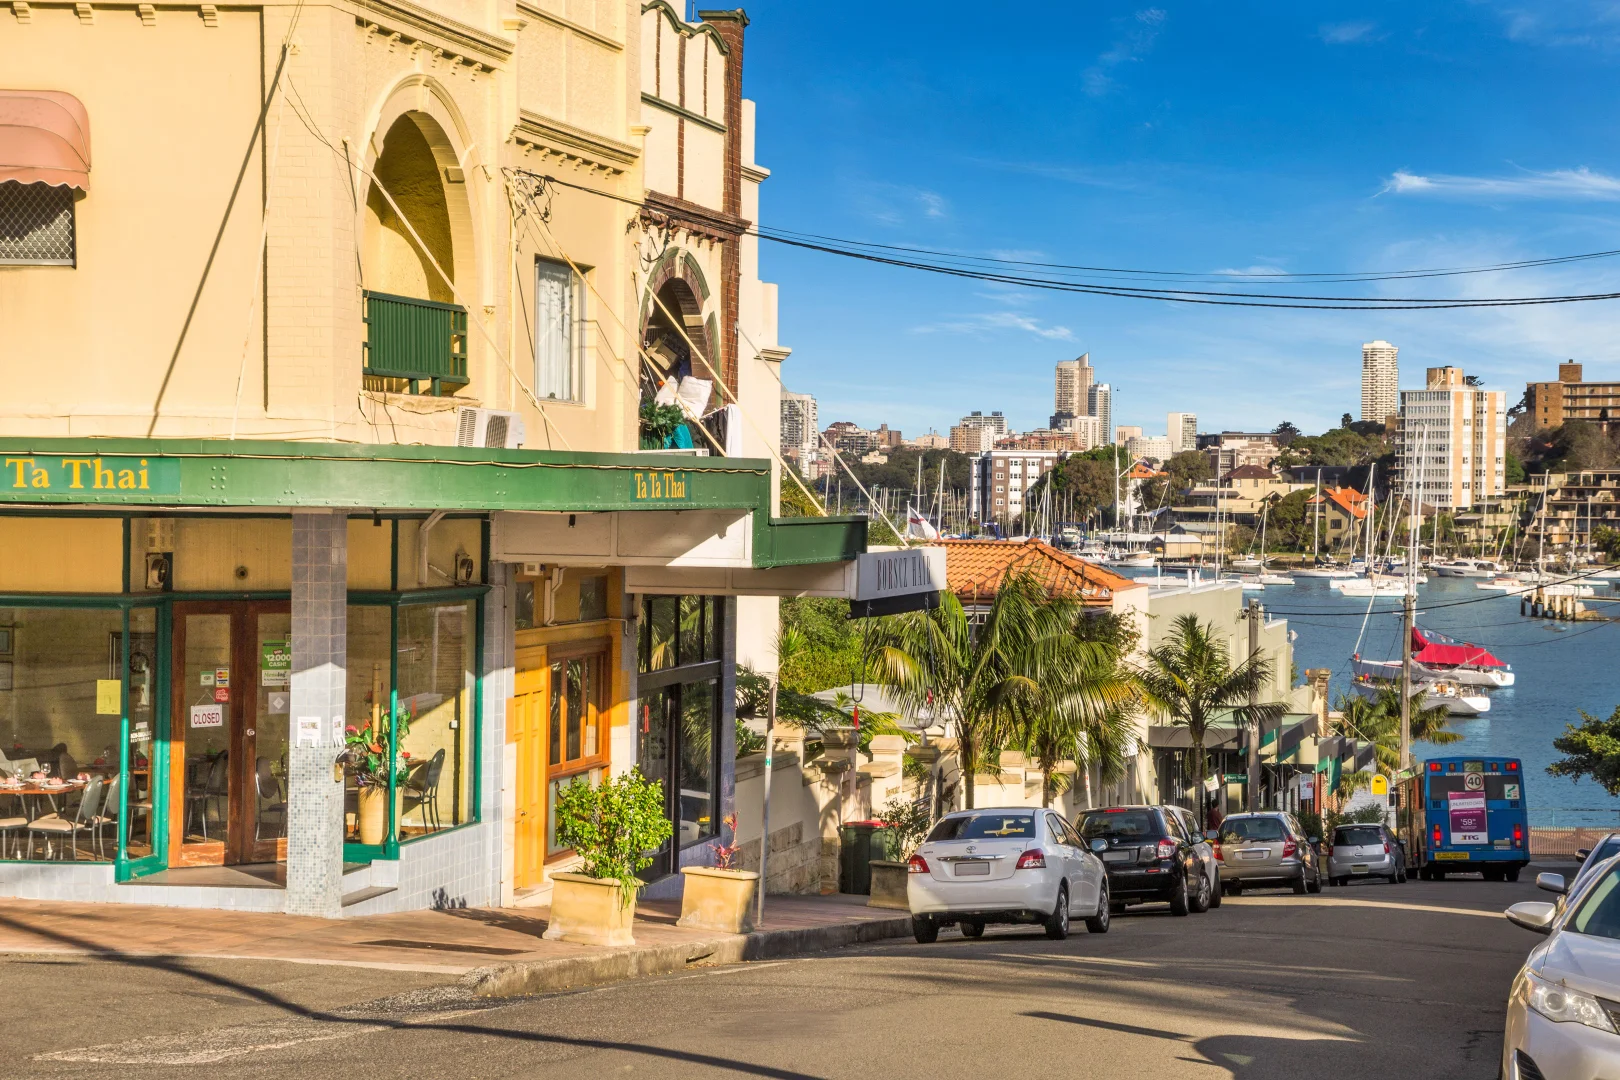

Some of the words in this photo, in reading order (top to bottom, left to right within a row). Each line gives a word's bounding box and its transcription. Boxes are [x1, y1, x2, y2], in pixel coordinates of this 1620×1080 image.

[5, 457, 51, 488] Ta
[61, 457, 150, 489] Thai
[634, 472, 647, 499] Ta
[649, 472, 661, 499] Ta
[663, 471, 686, 498] Thai
[194, 712, 220, 725] CLOSED
[1467, 776, 1481, 786] 40
